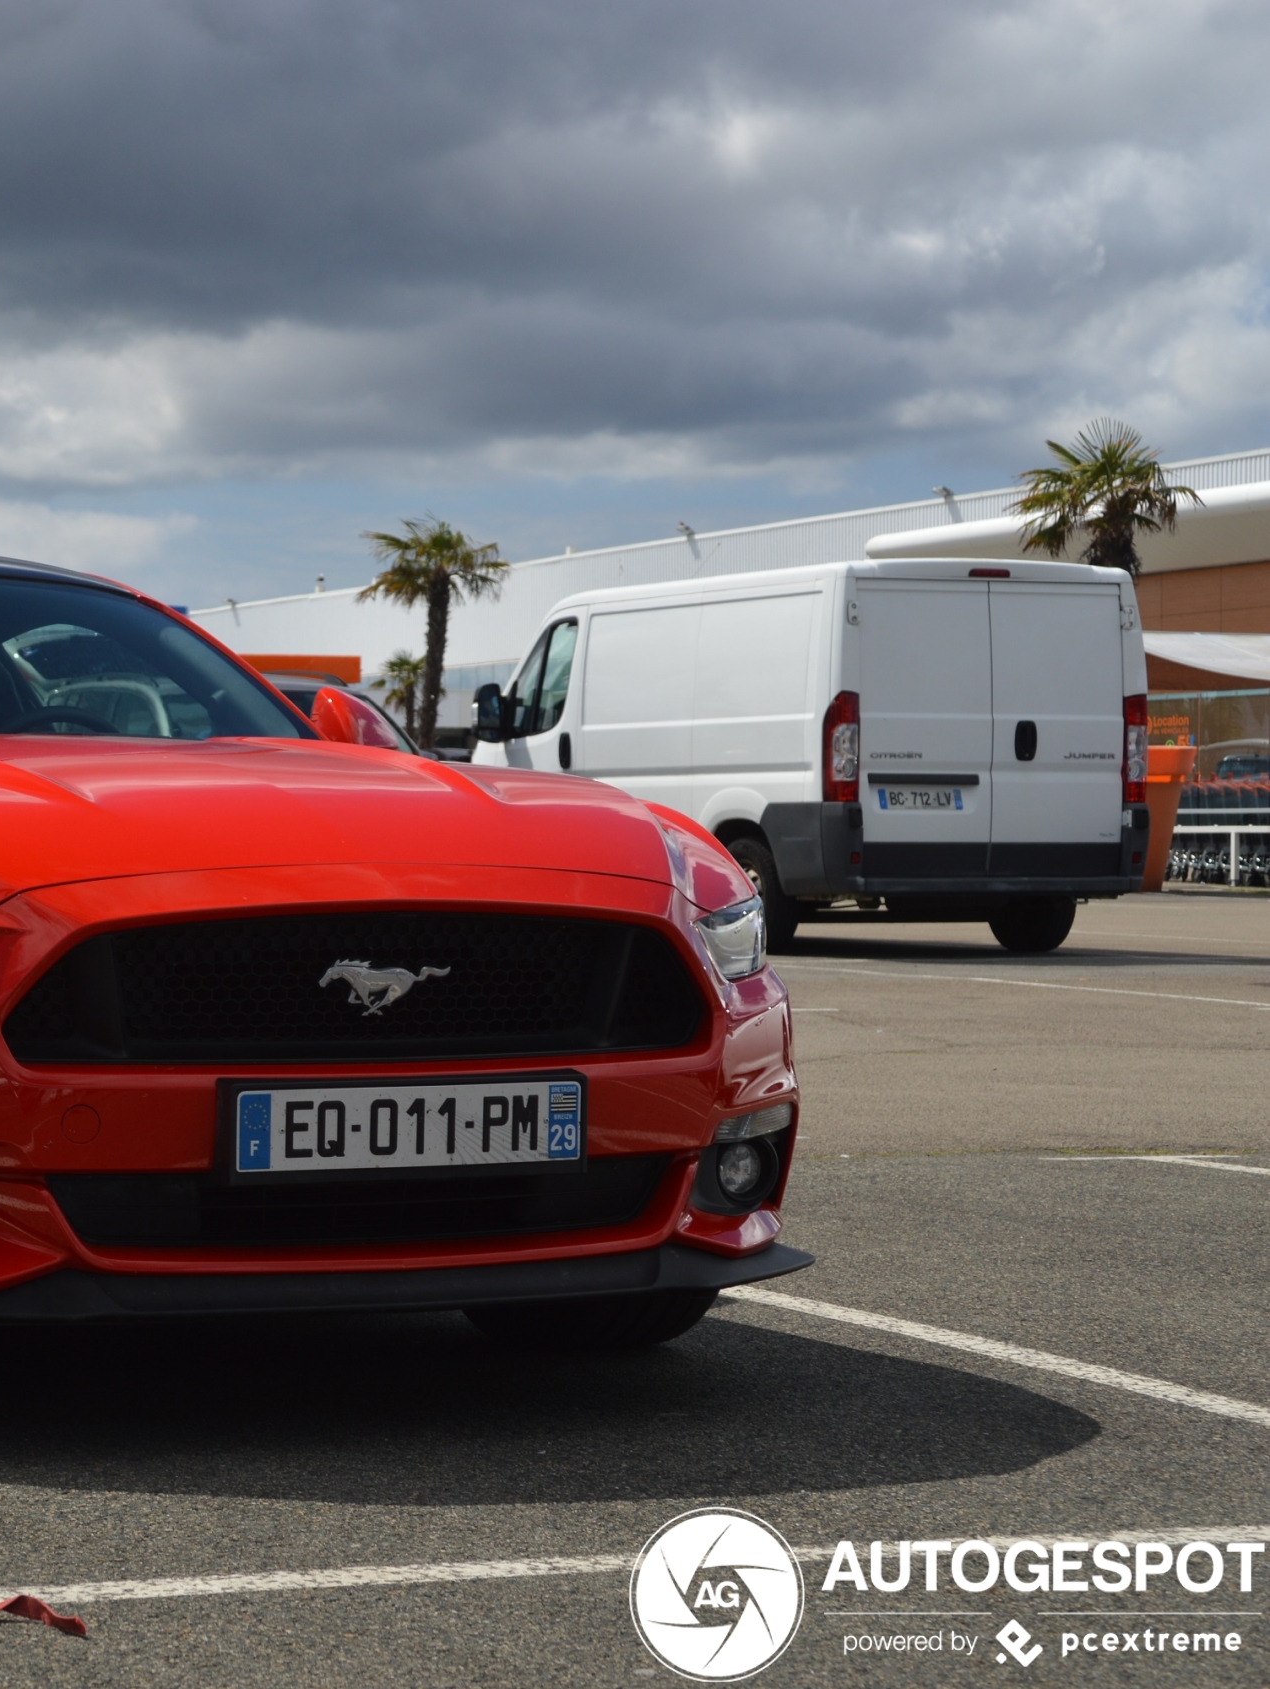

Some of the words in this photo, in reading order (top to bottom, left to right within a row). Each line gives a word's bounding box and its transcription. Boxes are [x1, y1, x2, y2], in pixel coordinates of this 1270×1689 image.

[1153, 714, 1190, 727] Location
[1063, 751, 1116, 759] JUMPER
[285, 1094, 539, 1159] EQ-011-PM
[550, 1123, 577, 1151] 29
[250, 1140, 260, 1156] F
